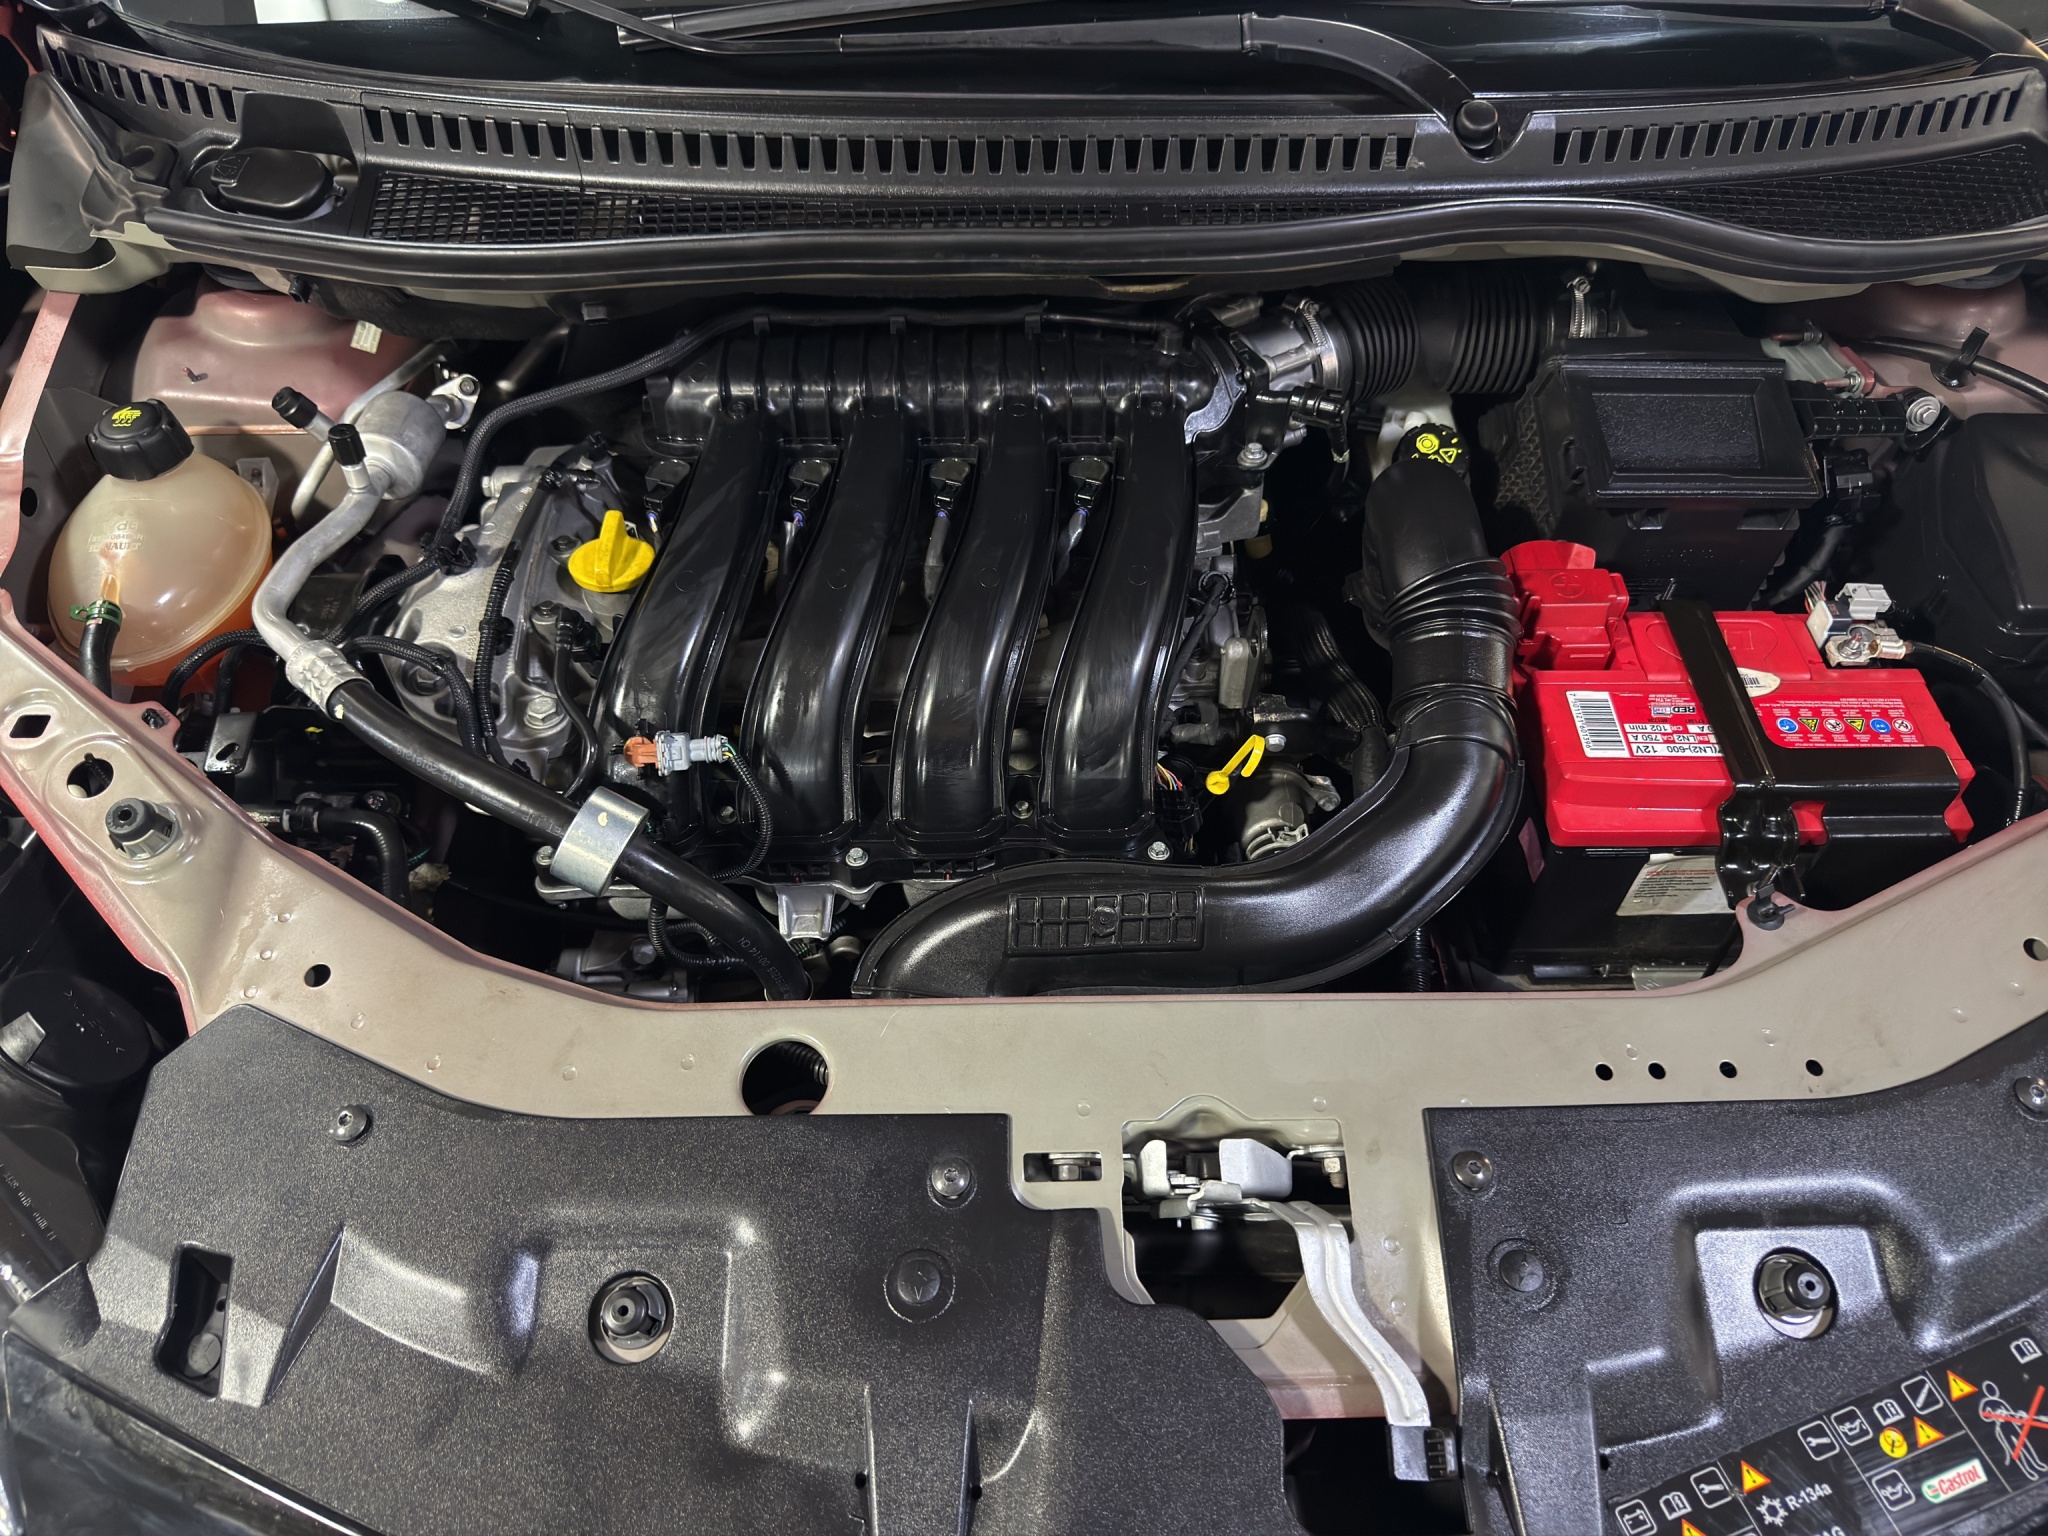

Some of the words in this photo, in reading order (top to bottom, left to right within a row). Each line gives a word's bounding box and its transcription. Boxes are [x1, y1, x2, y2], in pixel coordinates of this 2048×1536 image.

[1579, 725, 1591, 748] 601396
[1635, 745, 1658, 754] 12V
[1937, 1466, 1981, 1496] Castrol
[1785, 1483, 1833, 1511] R-134a
